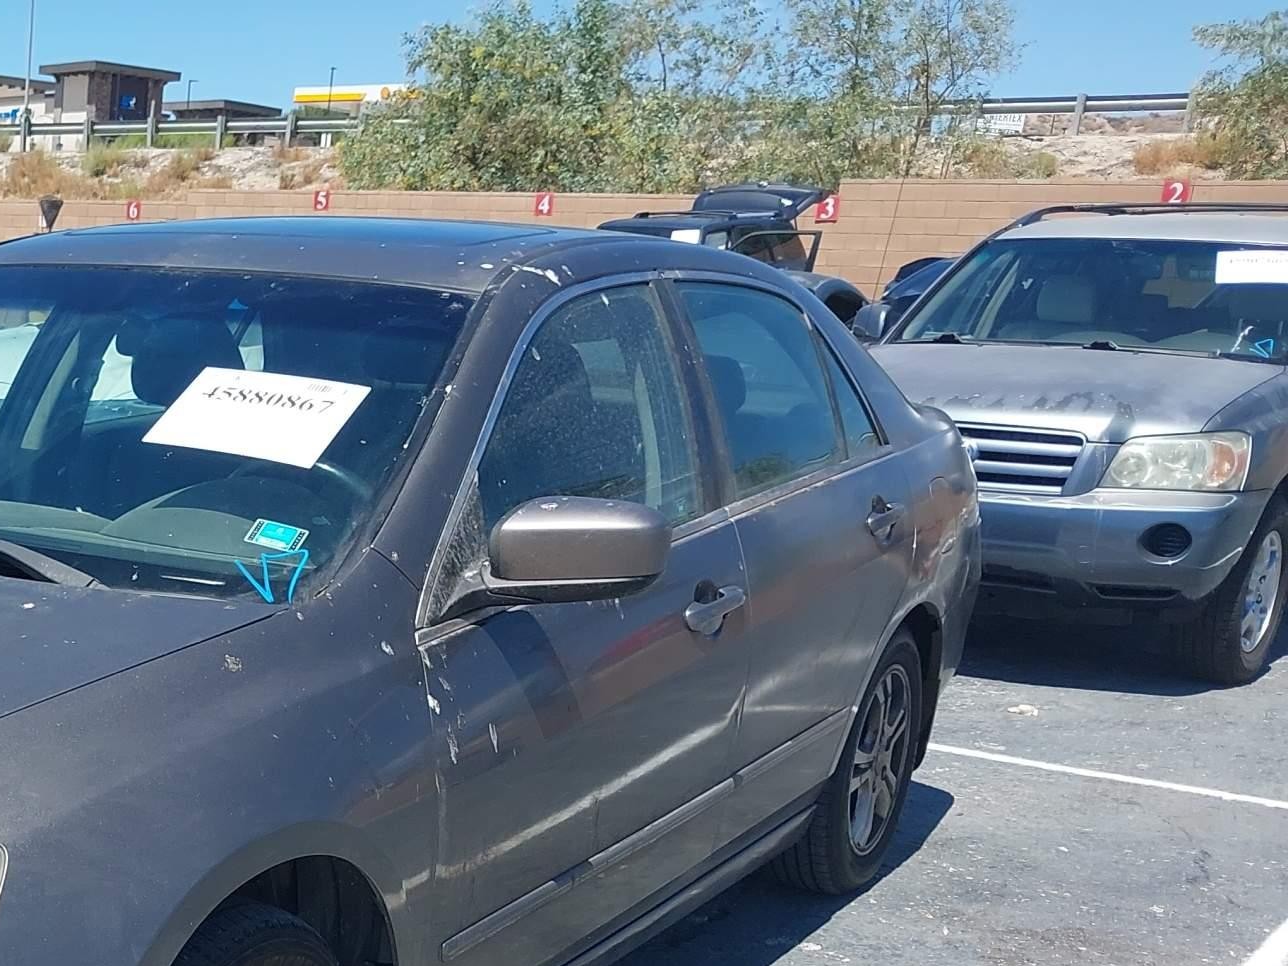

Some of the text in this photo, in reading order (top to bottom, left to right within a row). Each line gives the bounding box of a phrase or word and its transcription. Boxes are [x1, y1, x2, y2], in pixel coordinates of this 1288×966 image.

[316, 191, 327, 210] 5
[1168, 182, 1184, 203] 2
[129, 202, 138, 219] 6
[538, 195, 550, 214] 4
[819, 198, 835, 219] 3
[202, 385, 335, 415] 45880867
